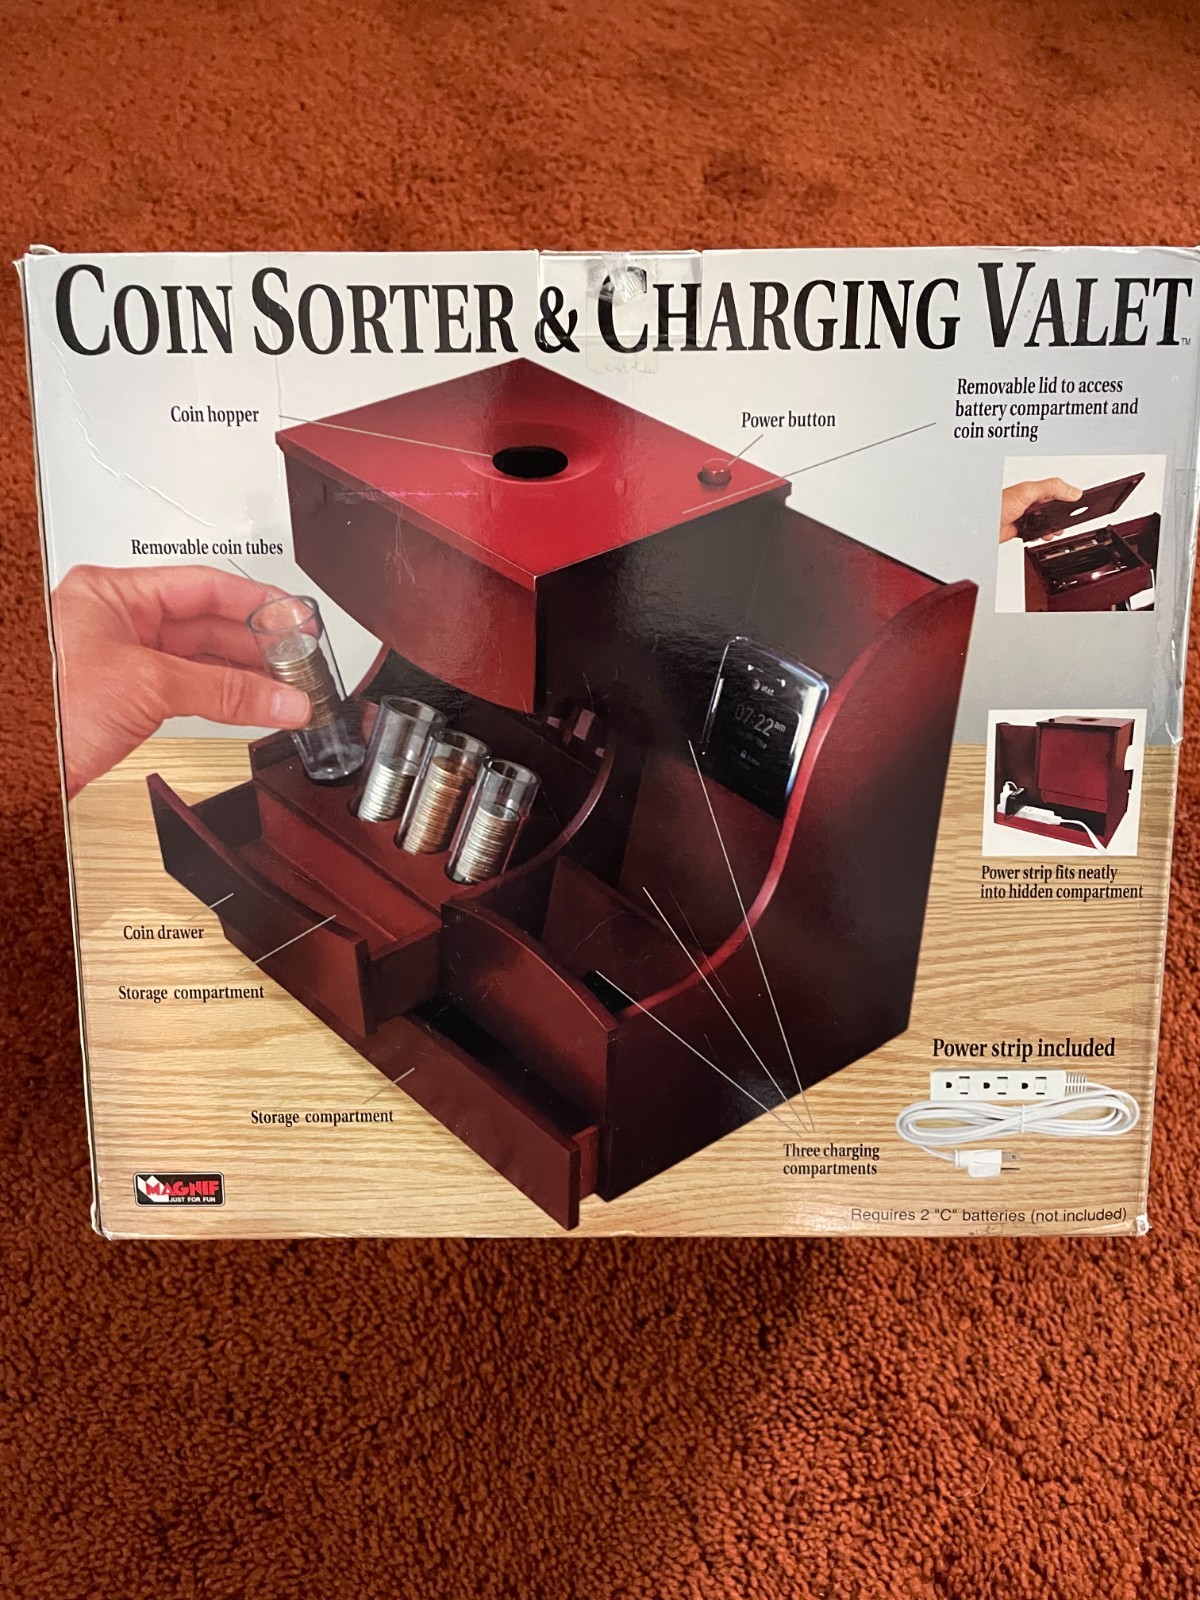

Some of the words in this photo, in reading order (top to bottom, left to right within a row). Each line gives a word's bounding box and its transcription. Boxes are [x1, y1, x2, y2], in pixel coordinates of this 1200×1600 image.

[56, 264, 233, 356] COIN
[252, 267, 518, 356] SORTER
[534, 285, 581, 354] &
[597, 265, 960, 353] CHARGING
[978, 262, 1193, 349] VALET
[957, 376, 1035, 395] Removable
[1038, 376, 1058, 394] lid
[1061, 379, 1076, 394] to
[1079, 379, 1124, 394] access
[170, 405, 205, 424] Coin
[207, 405, 260, 427] hopper
[955, 399, 1007, 422] battery
[1010, 399, 1109, 420] compartment
[1111, 398, 1139, 416] and
[741, 411, 784, 429] Power
[787, 411, 836, 428] button
[953, 423, 984, 440] coin
[987, 422, 1039, 443] sorting
[131, 538, 210, 556] Removable
[212, 540, 243, 556] coin
[245, 538, 284, 556] tubes
[981, 865, 1021, 881] Power
[1022, 864, 1053, 883] strip
[1055, 864, 1076, 881] fits
[1077, 864, 1118, 883] neatly
[980, 884, 1006, 899] into
[1008, 883, 1054, 899] hidden
[1056, 886, 1143, 902] compartment
[123, 924, 156, 941] Coin
[157, 924, 205, 940] drawer
[118, 985, 168, 1004] Storage
[173, 985, 265, 1003] compartment
[932, 1038, 988, 1058] Power
[990, 1038, 1034, 1063] strip
[1037, 1037, 1116, 1058] included
[250, 1109, 300, 1128] Storage
[304, 1109, 394, 1128] compartment
[783, 1142, 821, 1158] Three
[823, 1142, 880, 1162] charging
[783, 1161, 878, 1178] compartments
[145, 1181, 220, 1196] MAGNIF
[850, 1208, 916, 1223] Requires
[920, 1208, 930, 1221] 2
[934, 1207, 958, 1222] "C"
[961, 1208, 1026, 1222] batteries
[1030, 1209, 1058, 1224] (not
[1063, 1206, 1128, 1224] included)
